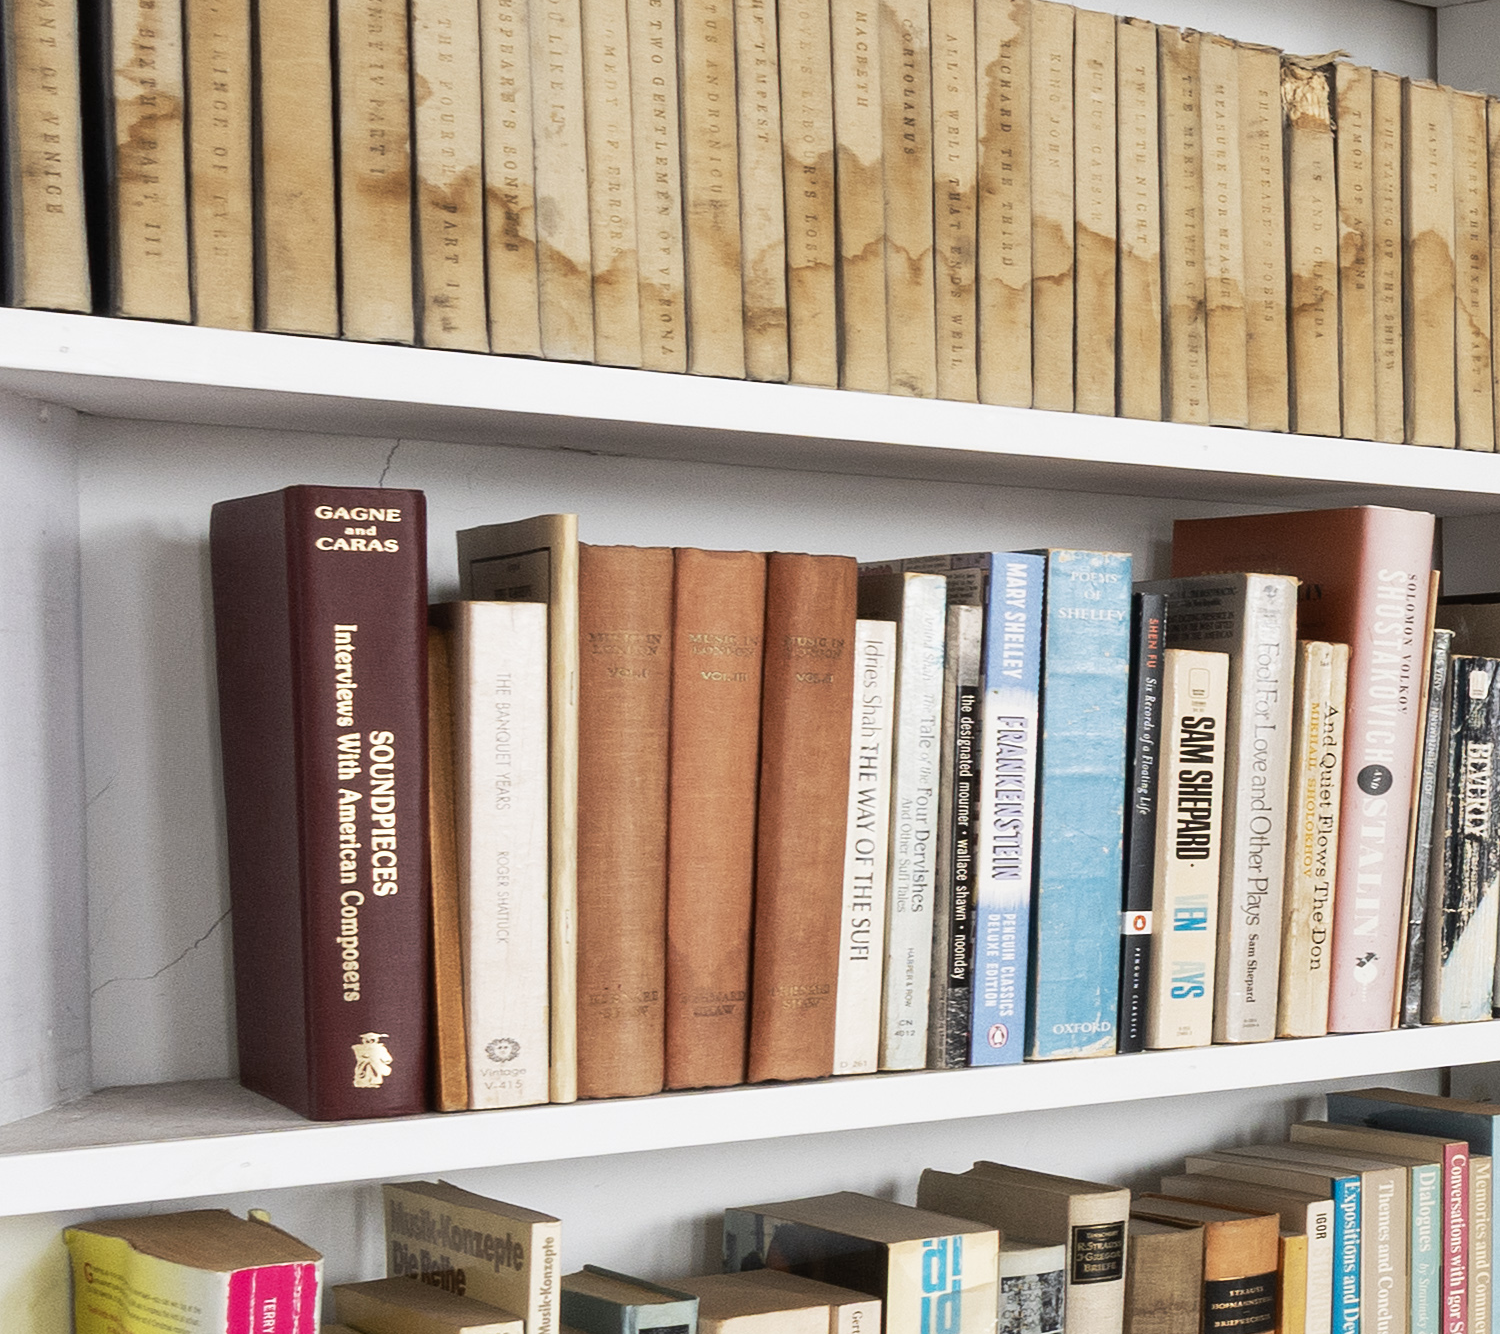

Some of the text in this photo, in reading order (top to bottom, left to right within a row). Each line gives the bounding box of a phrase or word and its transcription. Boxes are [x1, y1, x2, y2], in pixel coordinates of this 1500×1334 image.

[315, 505, 401, 524] GAGNE
[315, 537, 400, 553] CARAS
[344, 525, 376, 537] and
[1005, 563, 1024, 679] MARY SHELLEY
[334, 623, 364, 1003] Interviews With American Composers
[369, 730, 398, 898] SOUNDPIECES
[991, 714, 1028, 880] FRANKENSTEIN
[1175, 714, 1217, 861] SAM SHEPARD
[1053, 1020, 1112, 1036] OXFORD
[260, 1296, 276, 1334] TERRY
